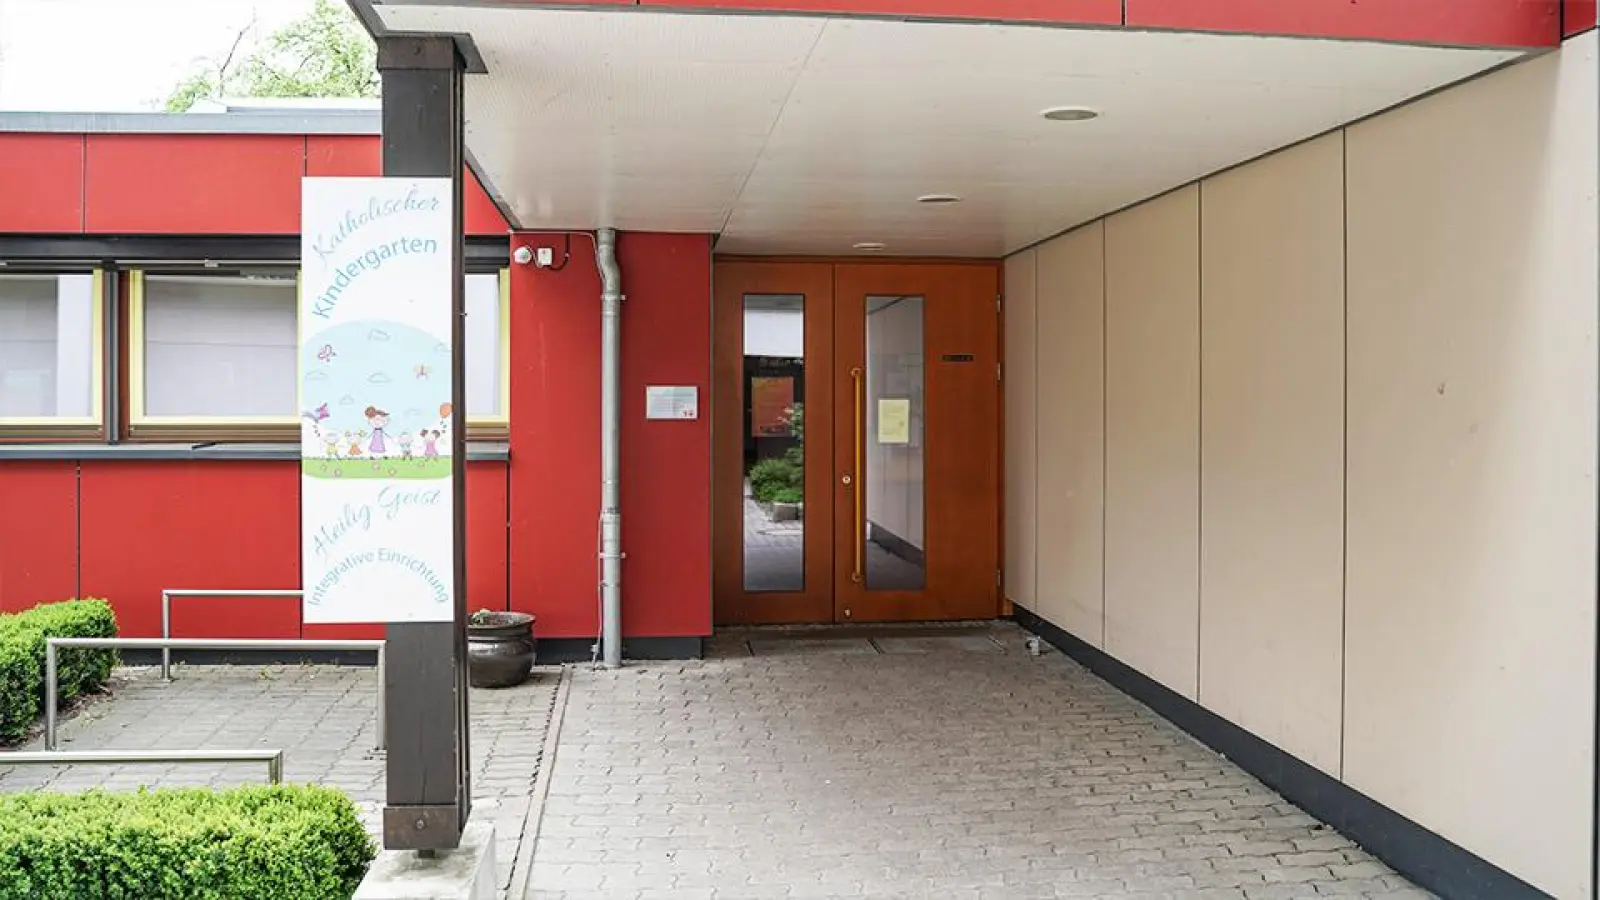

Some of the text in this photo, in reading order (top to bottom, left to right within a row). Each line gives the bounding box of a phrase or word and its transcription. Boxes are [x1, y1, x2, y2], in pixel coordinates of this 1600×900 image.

[312, 184, 440, 268] Katholischer
[312, 236, 438, 319] Kindergarten
[312, 484, 441, 564] Heilig Geist
[308, 547, 449, 606] Integrative Einrichtung
